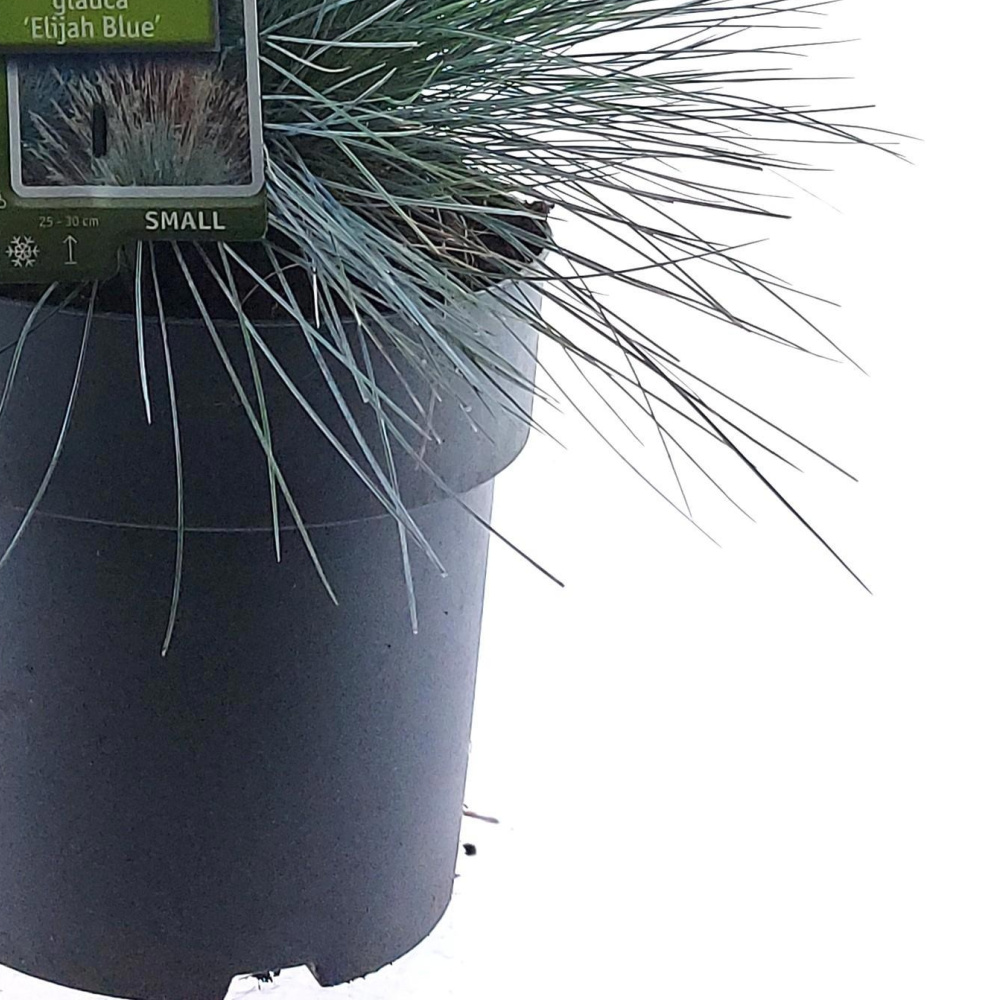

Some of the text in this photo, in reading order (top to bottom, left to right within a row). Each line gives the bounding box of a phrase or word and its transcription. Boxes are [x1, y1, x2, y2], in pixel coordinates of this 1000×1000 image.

[39, 215, 53, 228] 25
[65, 215, 79, 228] 30
[82, 217, 100, 228] cm
[145, 211, 226, 230] SMALL
